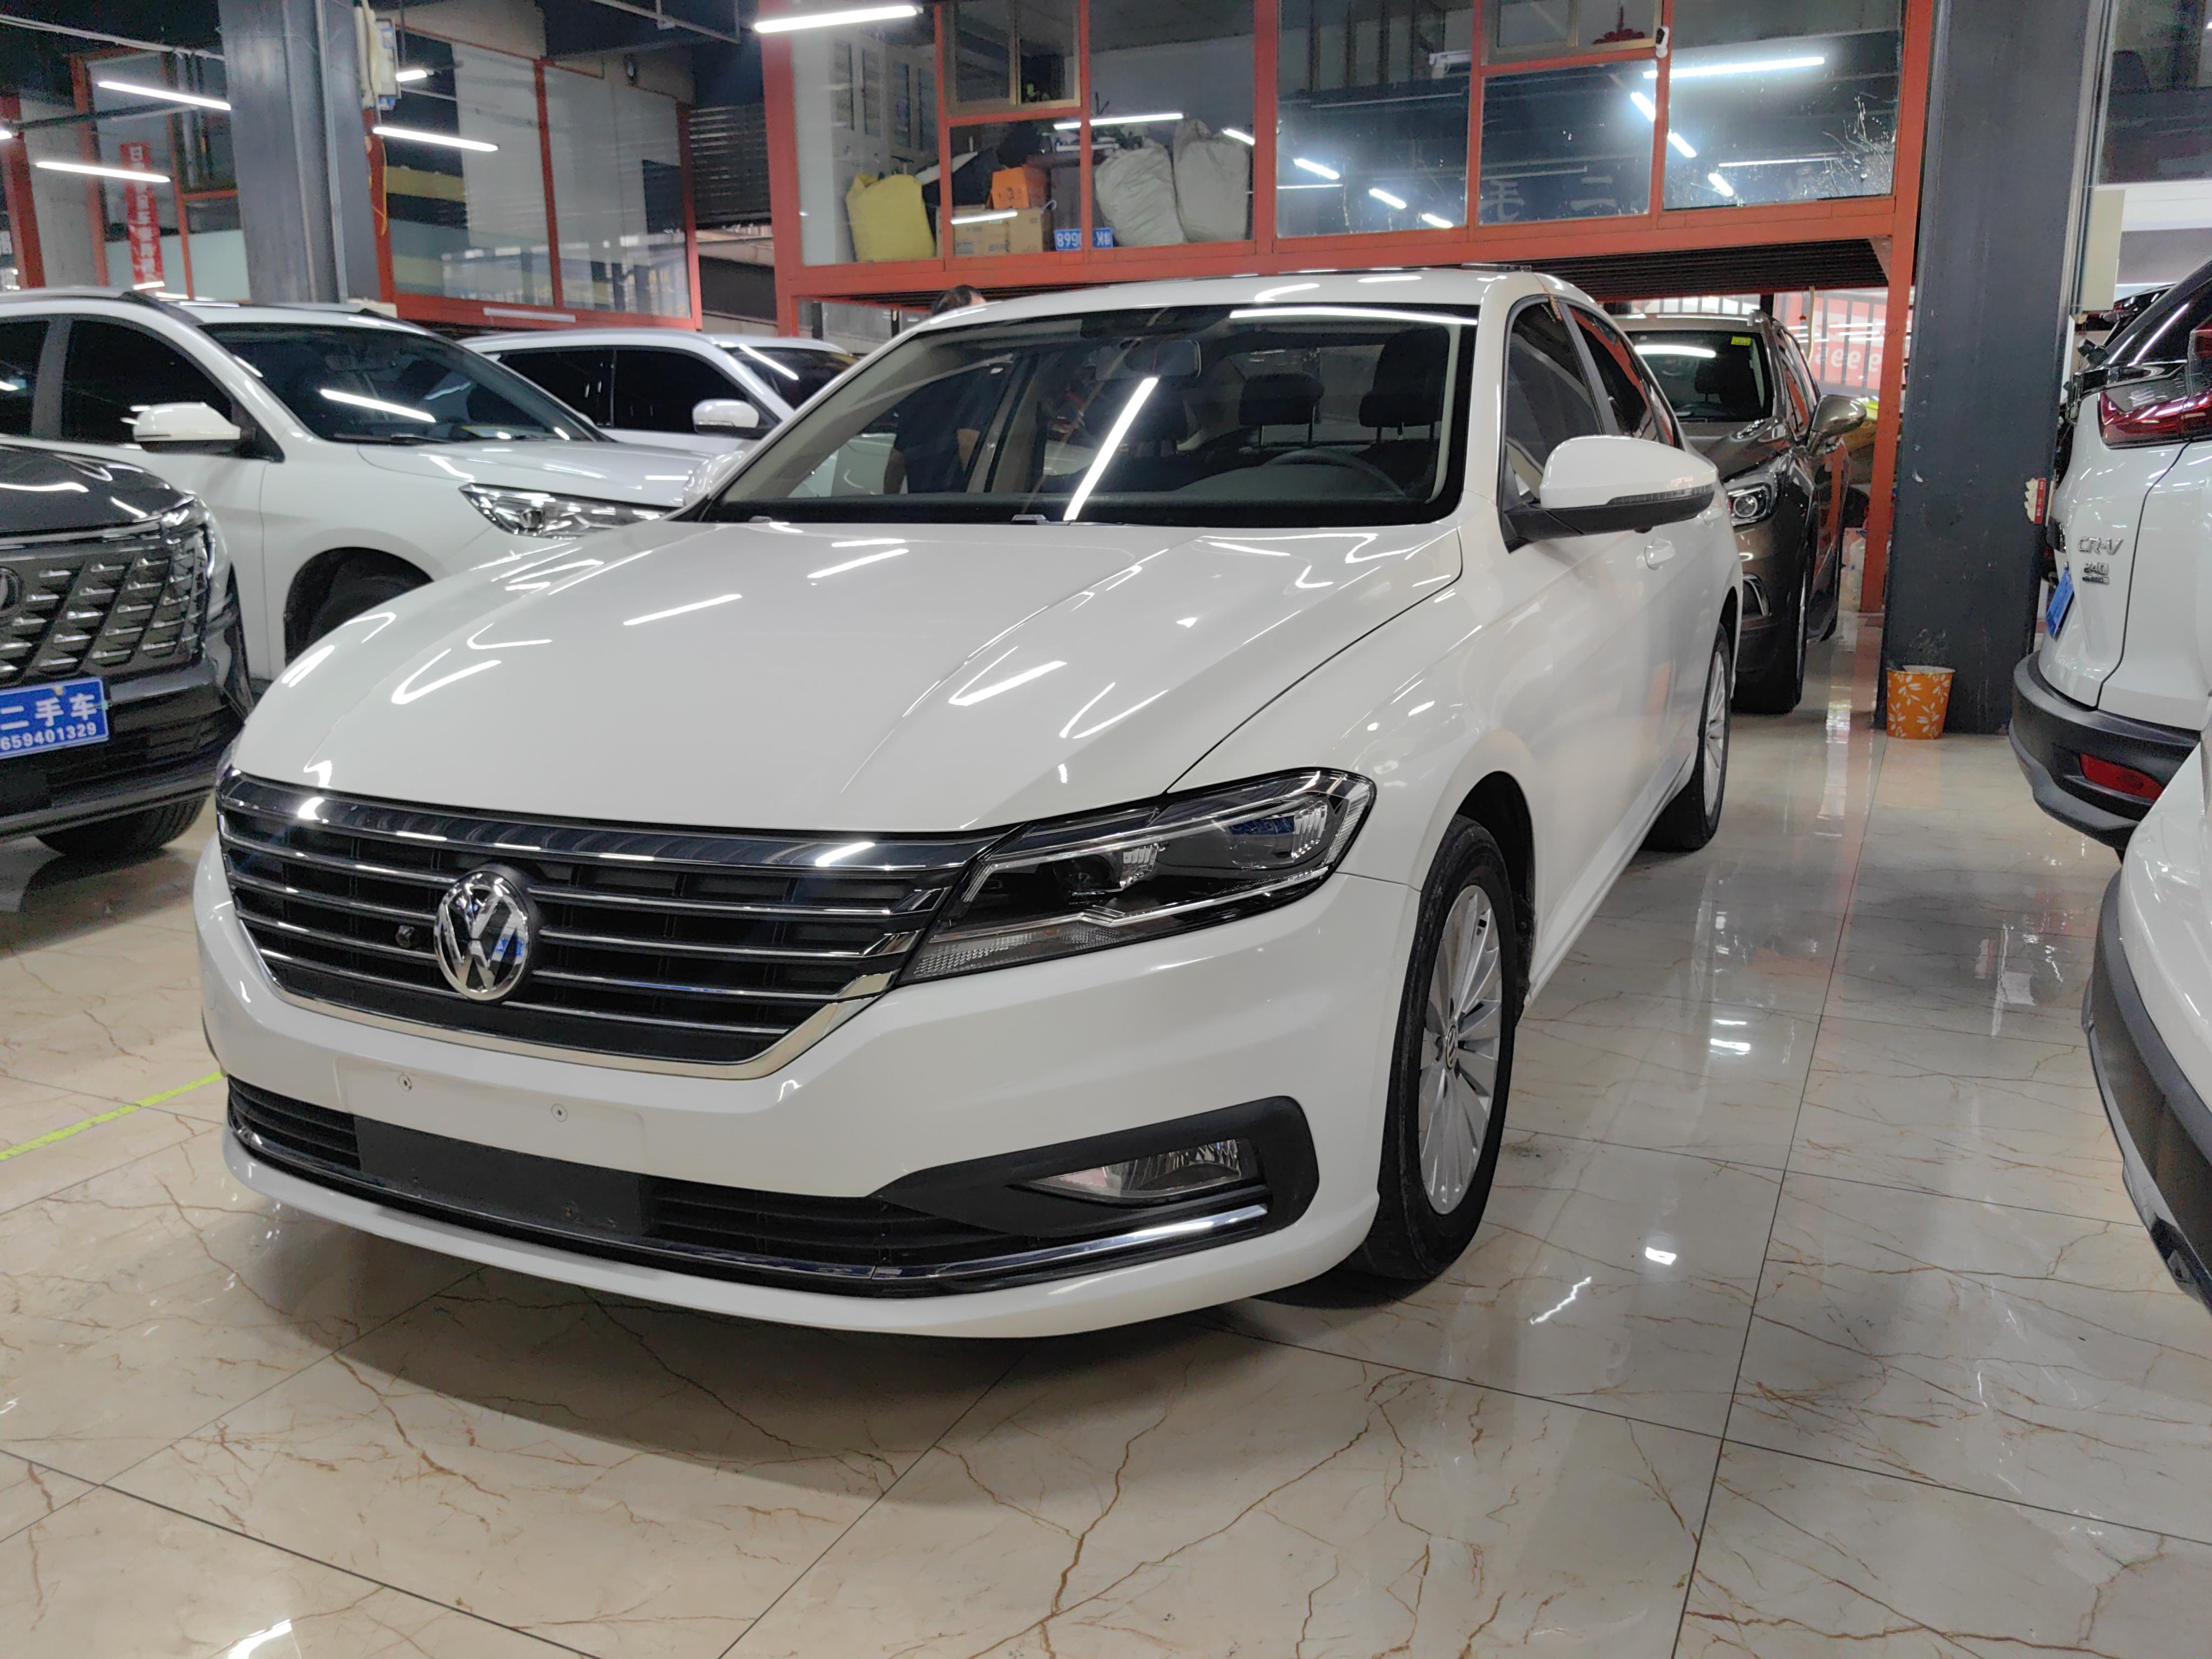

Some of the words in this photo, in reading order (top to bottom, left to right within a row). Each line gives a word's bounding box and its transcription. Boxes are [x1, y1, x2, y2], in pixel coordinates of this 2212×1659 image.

[2078, 537, 2124, 555] CR-V
[0, 692, 97, 730] 二手车
